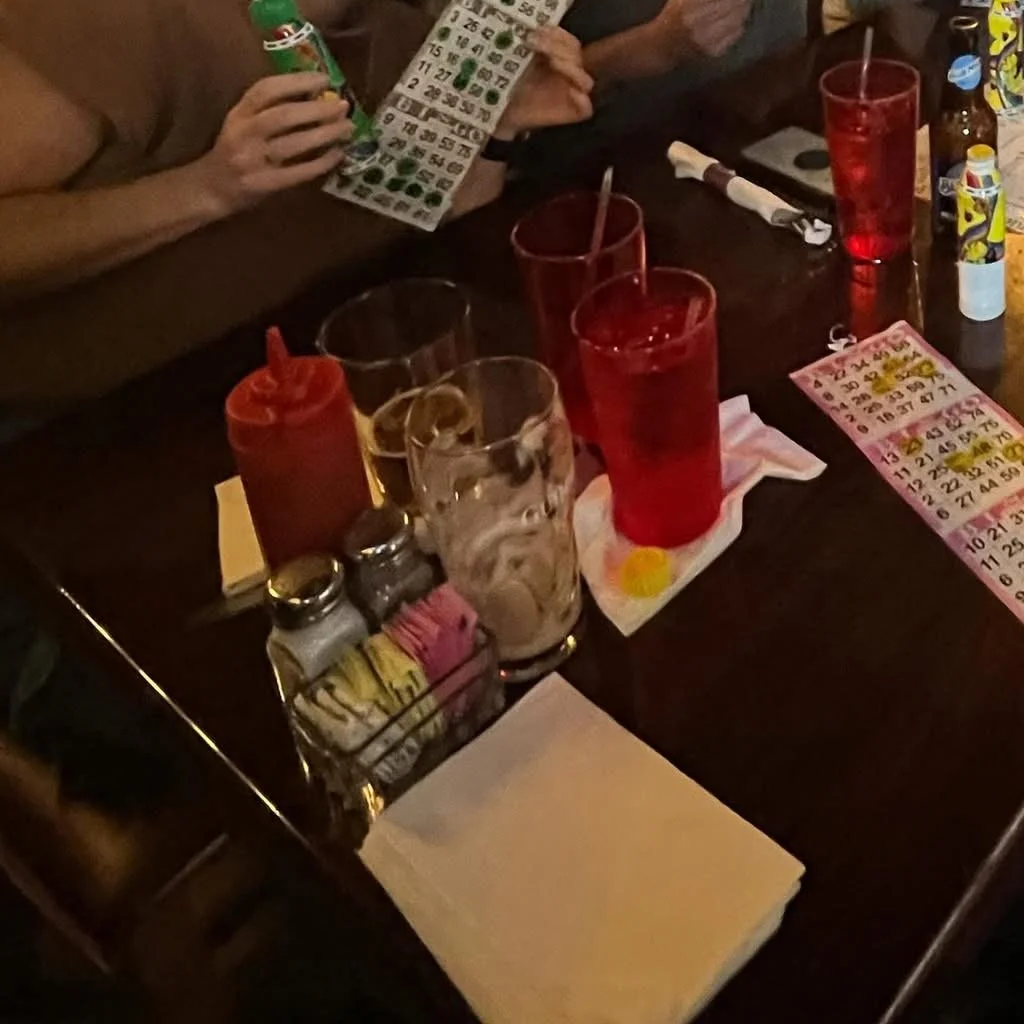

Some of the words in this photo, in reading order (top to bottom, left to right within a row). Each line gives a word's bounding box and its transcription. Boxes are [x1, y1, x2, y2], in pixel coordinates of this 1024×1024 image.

[408, 78, 419, 90] 2
[896, 401, 915, 415] 37
[920, 392, 935, 404] 47
[937, 383, 958, 396] 71
[880, 452, 900, 465] 13
[926, 427, 944, 441] 43
[894, 467, 912, 480] 11
[915, 453, 934, 468] 21
[938, 441, 957, 455] 45
[906, 480, 924, 494] 12
[928, 465, 948, 480] 25
[995, 431, 1013, 445] 70
[922, 494, 934, 506] 2
[941, 478, 961, 494] 22
[963, 467, 983, 481] 32
[986, 456, 1005, 470] 51
[937, 509, 949, 520] 6
[955, 492, 976, 509] 27
[979, 480, 1000, 495] 44
[1000, 467, 1020, 482] 59
[965, 538, 985, 554] 10
[987, 524, 1008, 541] 21
[981, 555, 1000, 571] 11
[1002, 538, 1024, 558] 25
